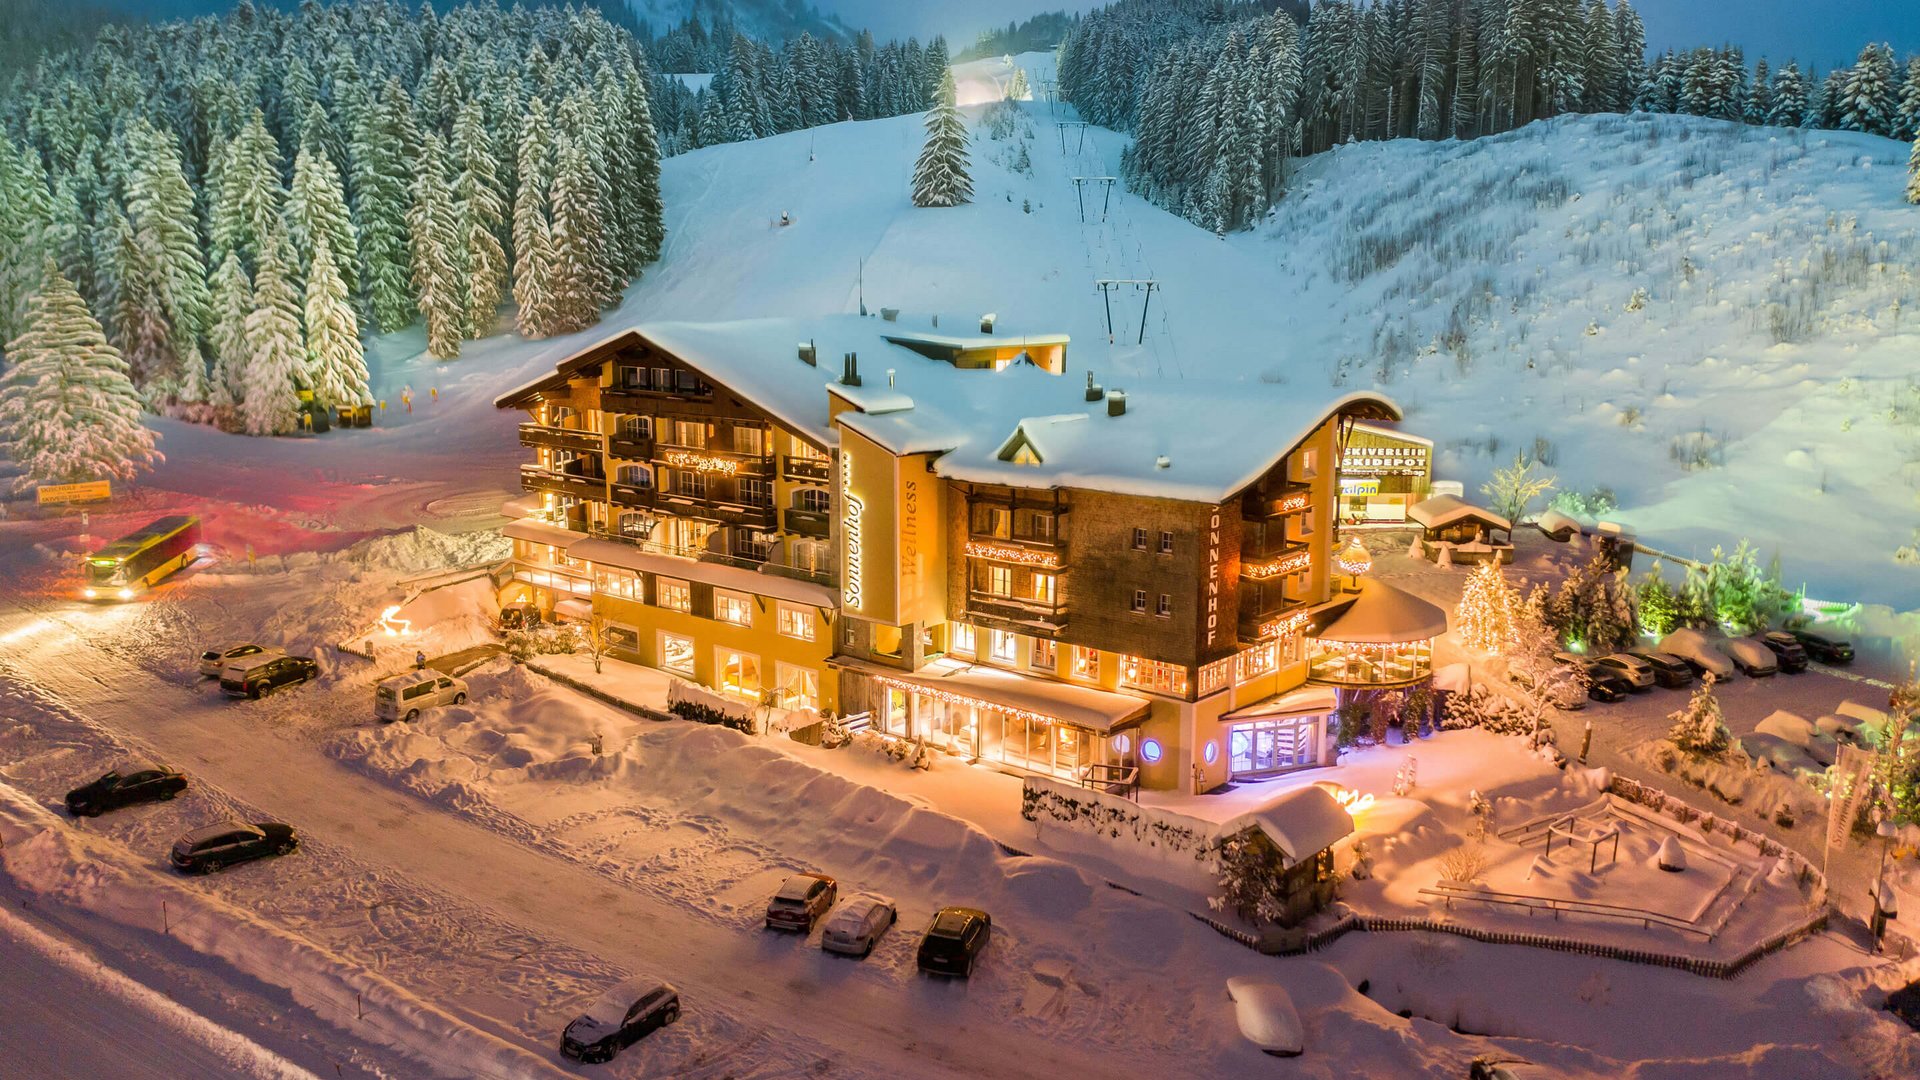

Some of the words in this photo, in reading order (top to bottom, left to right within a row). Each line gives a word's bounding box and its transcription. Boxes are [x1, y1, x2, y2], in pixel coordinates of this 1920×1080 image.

[1344, 447, 1426, 456] SKIVERLEIH
[1343, 458, 1426, 466] SKIDEPOT
[1402, 468, 1425, 477] Shop
[902, 480, 917, 577] Wellness
[844, 490, 863, 608] Sonnenhof
